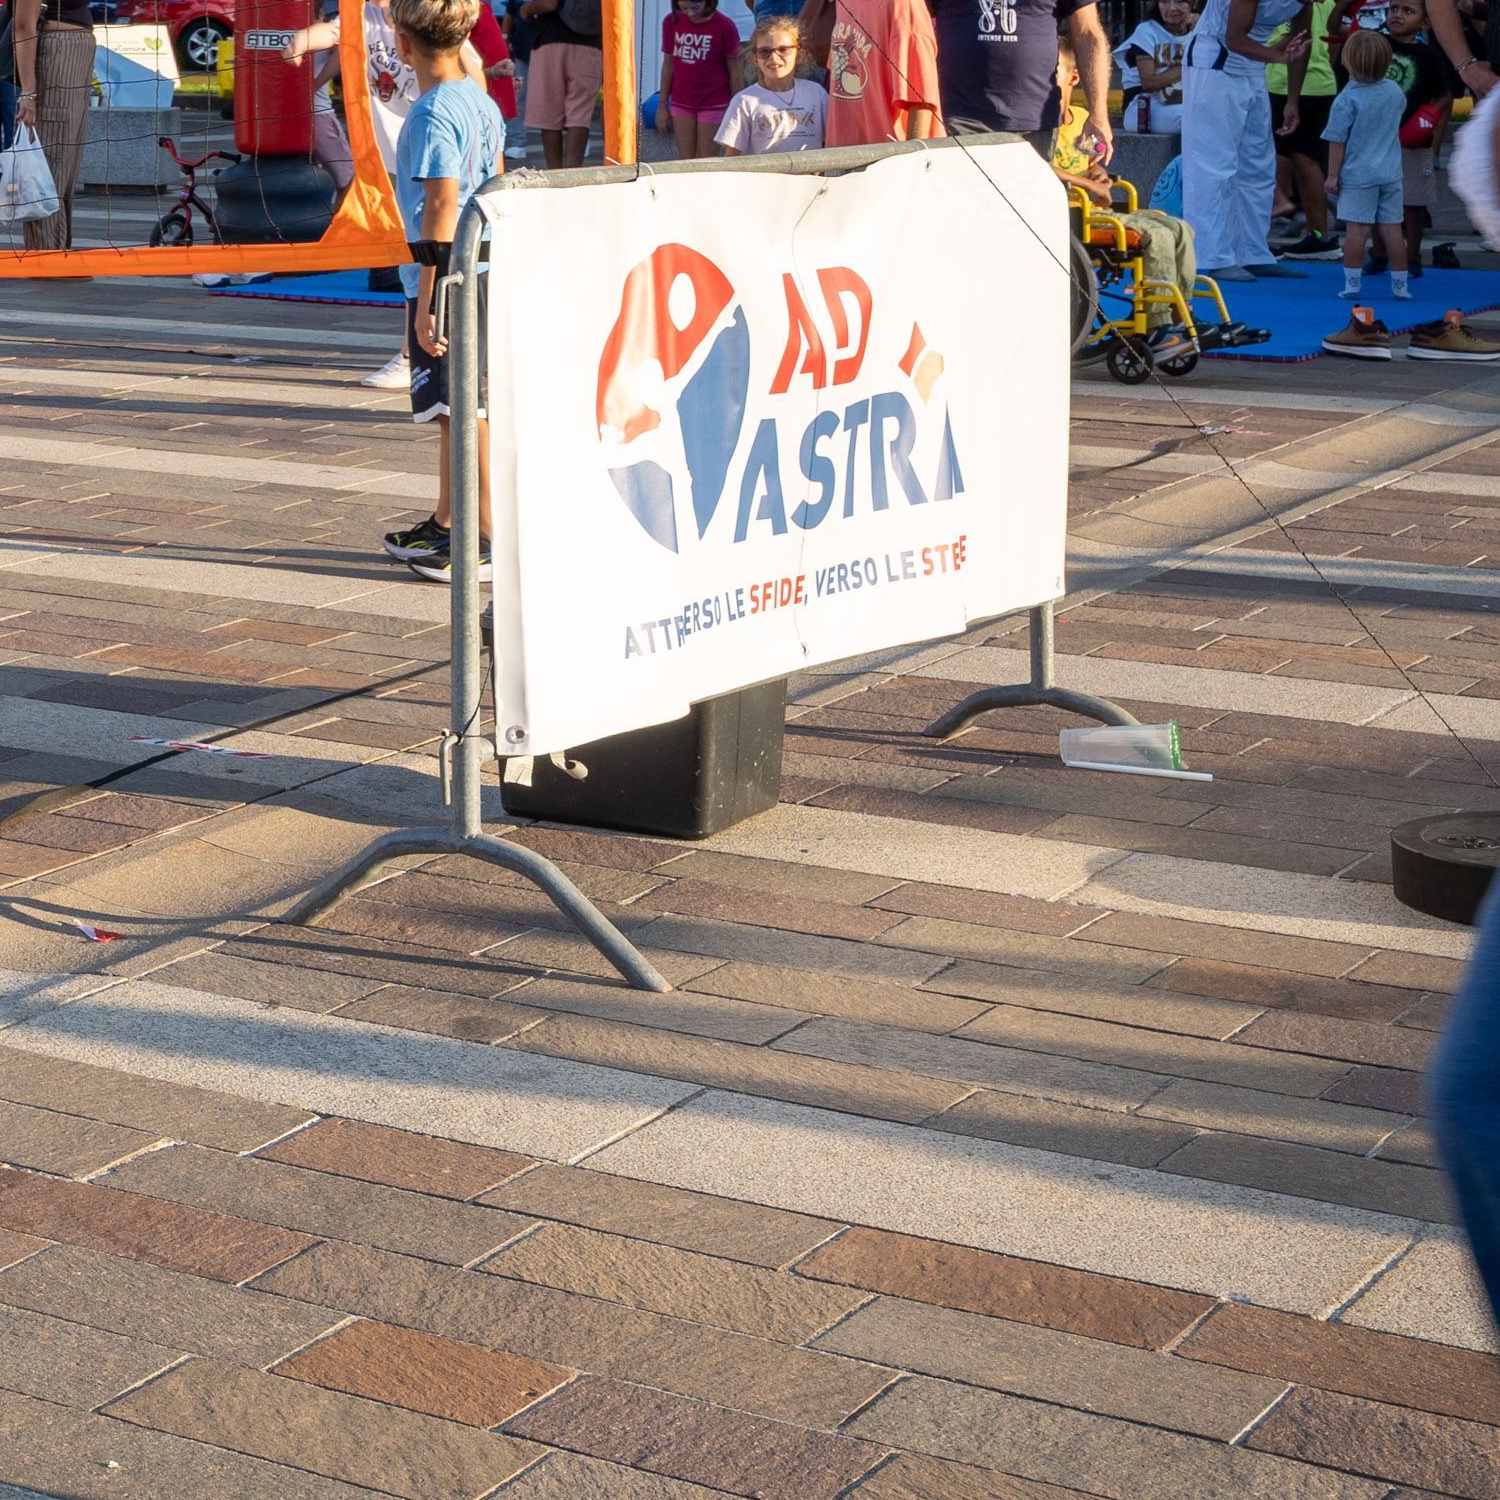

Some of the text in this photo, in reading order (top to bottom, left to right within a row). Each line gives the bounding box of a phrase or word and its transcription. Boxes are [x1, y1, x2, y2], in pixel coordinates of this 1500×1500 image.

[672, 46, 710, 61] MENT
[674, 32, 713, 47] MOVE
[768, 266, 873, 395] AD
[733, 390, 966, 544] ASTRA
[725, 587, 746, 622] LE
[750, 574, 808, 614] SFIDE,
[815, 557, 879, 599] VERSO
[885, 550, 917, 583] LE
